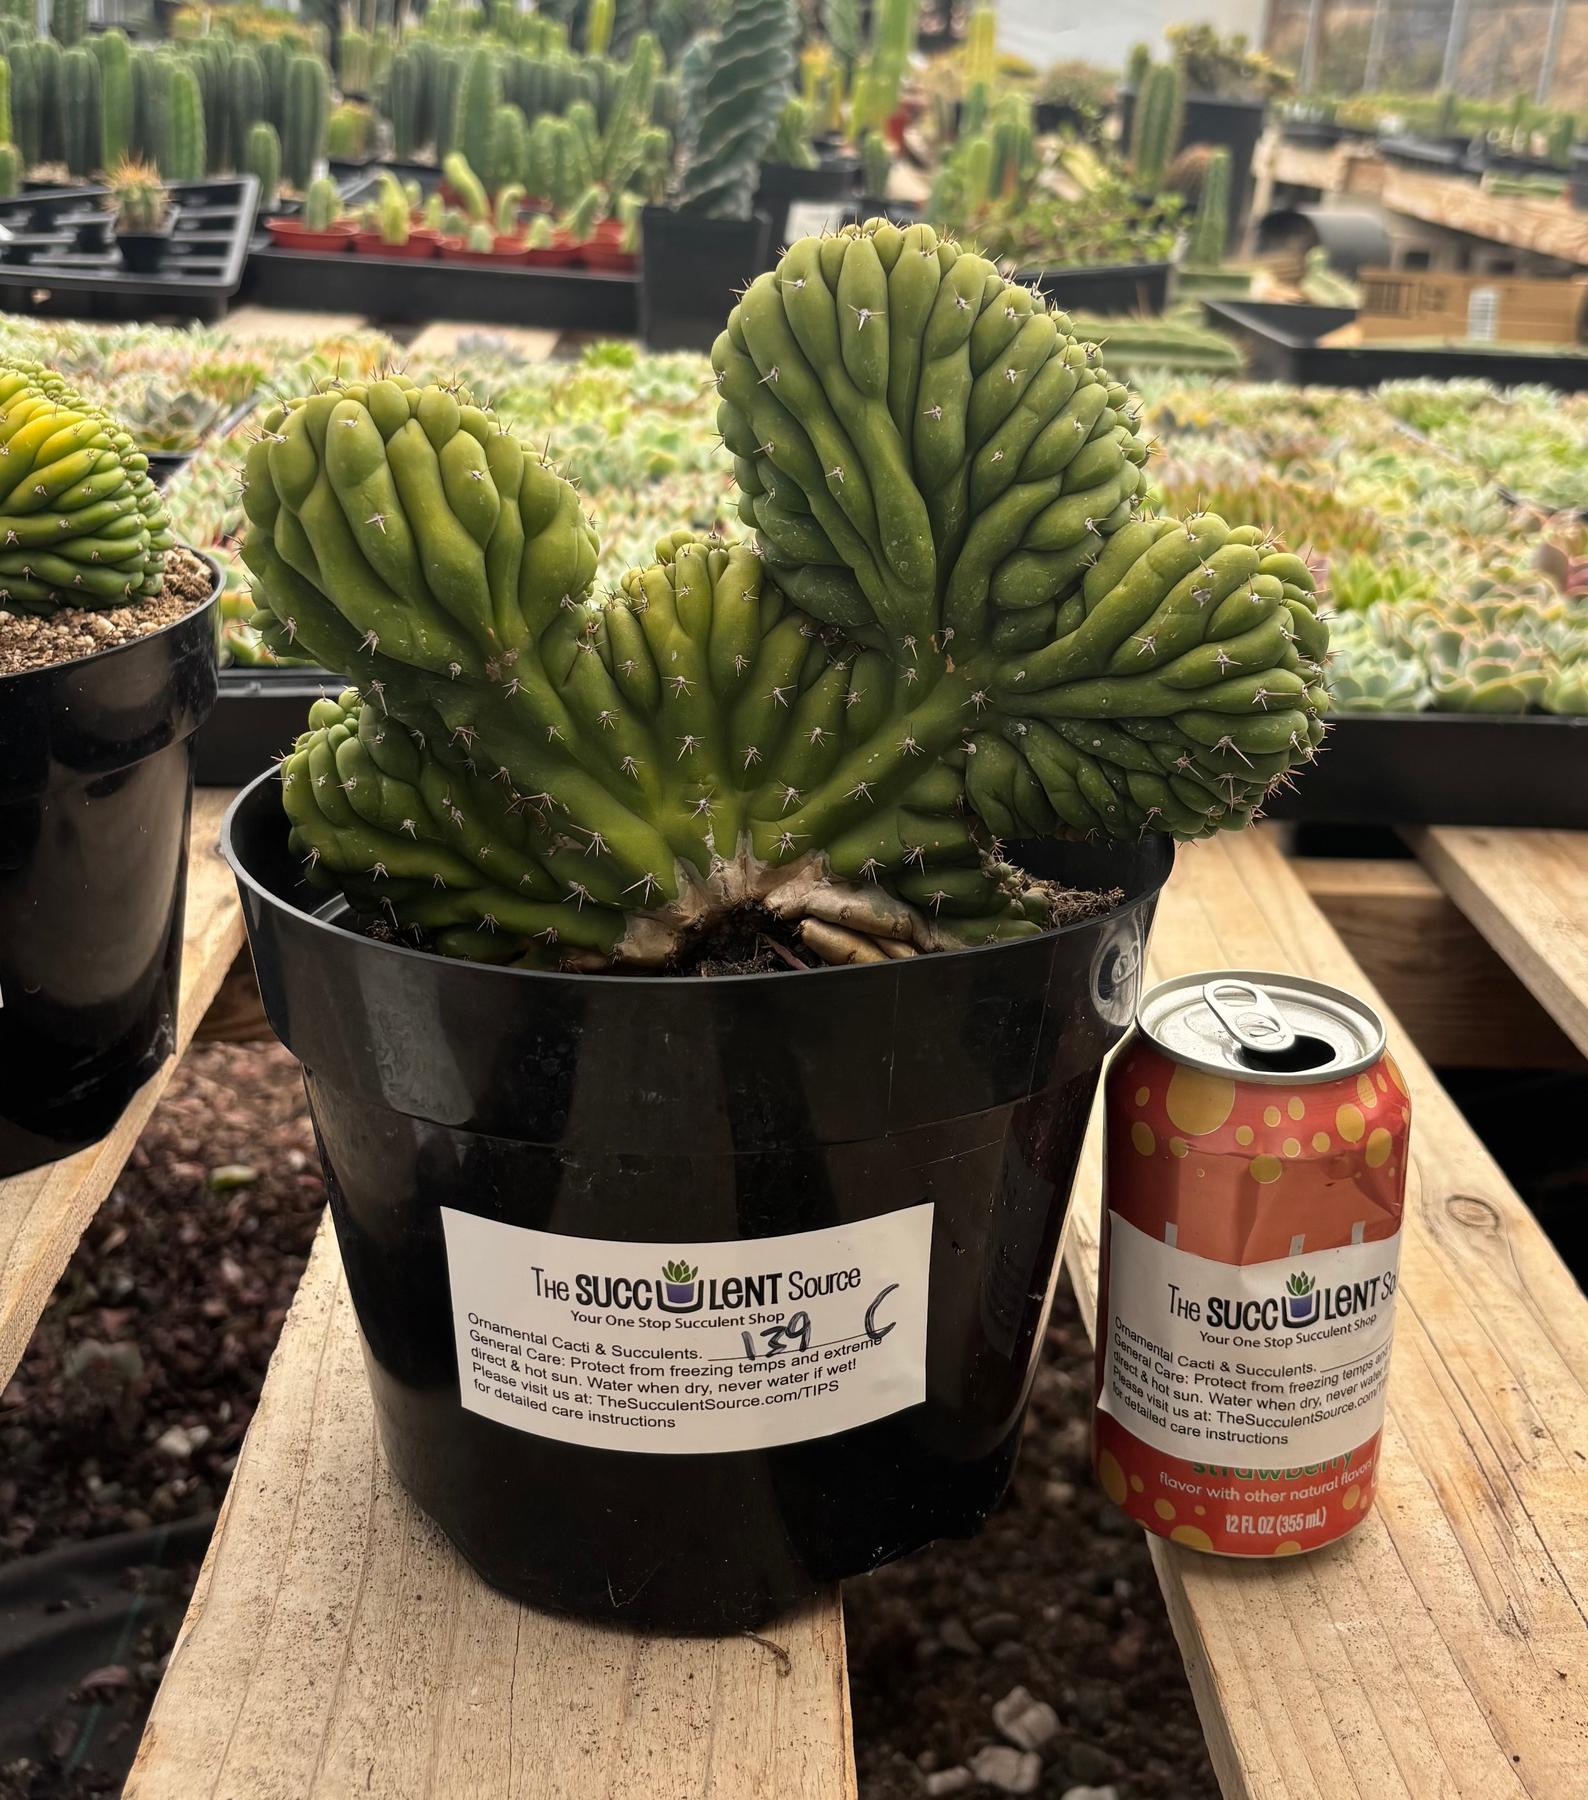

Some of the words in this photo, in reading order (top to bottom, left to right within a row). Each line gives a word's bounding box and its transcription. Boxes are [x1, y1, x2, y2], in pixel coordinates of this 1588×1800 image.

[788, 1267, 861, 1301] Source
[468, 1312, 547, 1346] Ornamental
[552, 1336, 590, 1354] Cacti
[595, 1343, 606, 1356] &
[611, 1344, 702, 1360] Succulents.
[570, 1310, 602, 1325] Your
[606, 1314, 635, 1328] One
[638, 1317, 672, 1331] Stop
[675, 1316, 745, 1329] Succulent
[749, 1312, 785, 1327] Shop
[741, 1310, 811, 1361] 139
[1200, 1331, 1230, 1346] Your
[1233, 1336, 1261, 1348] One
[1264, 1336, 1293, 1349] Stop
[1296, 1323, 1352, 1344] Succulent
[1354, 1314, 1377, 1331] Shop
[469, 1329, 522, 1357] General
[527, 1347, 565, 1367] Care:
[571, 1357, 625, 1375] Protect
[629, 1363, 665, 1377] from
[670, 1362, 733, 1378] freezing
[739, 1359, 786, 1377] temps
[791, 1349, 819, 1368] and
[824, 1336, 882, 1361] extreme
[471, 1347, 506, 1368] direct
[511, 1359, 522, 1372] &
[525, 1363, 547, 1380] hot
[551, 1372, 582, 1386] sun.
[587, 1376, 633, 1393] Water
[637, 1380, 680, 1394] when
[685, 1381, 713, 1396] dry,
[718, 1380, 762, 1393] never
[767, 1371, 809, 1388] water
[813, 1366, 823, 1380] if
[826, 1358, 857, 1377] wet!
[1114, 1333, 1151, 1368] General
[1155, 1362, 1189, 1384] Care:
[1194, 1373, 1247, 1390] Protect
[1251, 1381, 1284, 1394] from
[1289, 1374, 1339, 1394] freezing
[1342, 1359, 1373, 1381] temps
[1115, 1316, 1173, 1363] Ornamental
[1178, 1355, 1215, 1370] Cacti
[1220, 1361, 1230, 1372] &
[1235, 1363, 1317, 1378] Succulents.
[473, 1362, 517, 1388] Please
[521, 1379, 548, 1396] visit
[552, 1388, 570, 1401] us
[574, 1391, 593, 1405] at:
[599, 1380, 839, 1411] TheSucculentSource.com/TIPS
[474, 1379, 491, 1395] for
[494, 1388, 547, 1412] detailed
[551, 1406, 584, 1420] care
[588, 1410, 676, 1428] instructions
[1113, 1365, 1144, 1398] Please
[1147, 1392, 1169, 1413] visit
[1173, 1406, 1189, 1418] us
[1194, 1410, 1212, 1422] at:
[1114, 1351, 1138, 1378] direct
[1141, 1370, 1148, 1384] &
[1151, 1377, 1170, 1397] hot
[1173, 1392, 1203, 1404] sun.
[1208, 1391, 1252, 1407] Water
[1256, 1398, 1296, 1411] when
[1300, 1396, 1322, 1410] dry,
[1326, 1383, 1358, 1403] never
[1360, 1366, 1383, 1389] water
[1112, 1381, 1123, 1399] for
[1125, 1395, 1166, 1428] detailed
[1171, 1422, 1201, 1438] care
[1206, 1427, 1288, 1445] instructions
[1159, 1472, 1202, 1495] flavor
[1207, 1487, 1240, 1501] with
[1245, 1488, 1286, 1502] other
[1290, 1475, 1339, 1500] natural
[1225, 1514, 1239, 1533] 12
[1241, 1515, 1256, 1534] FL
[1258, 1516, 1276, 1535] OZ
[1276, 1513, 1304, 1537] (355
